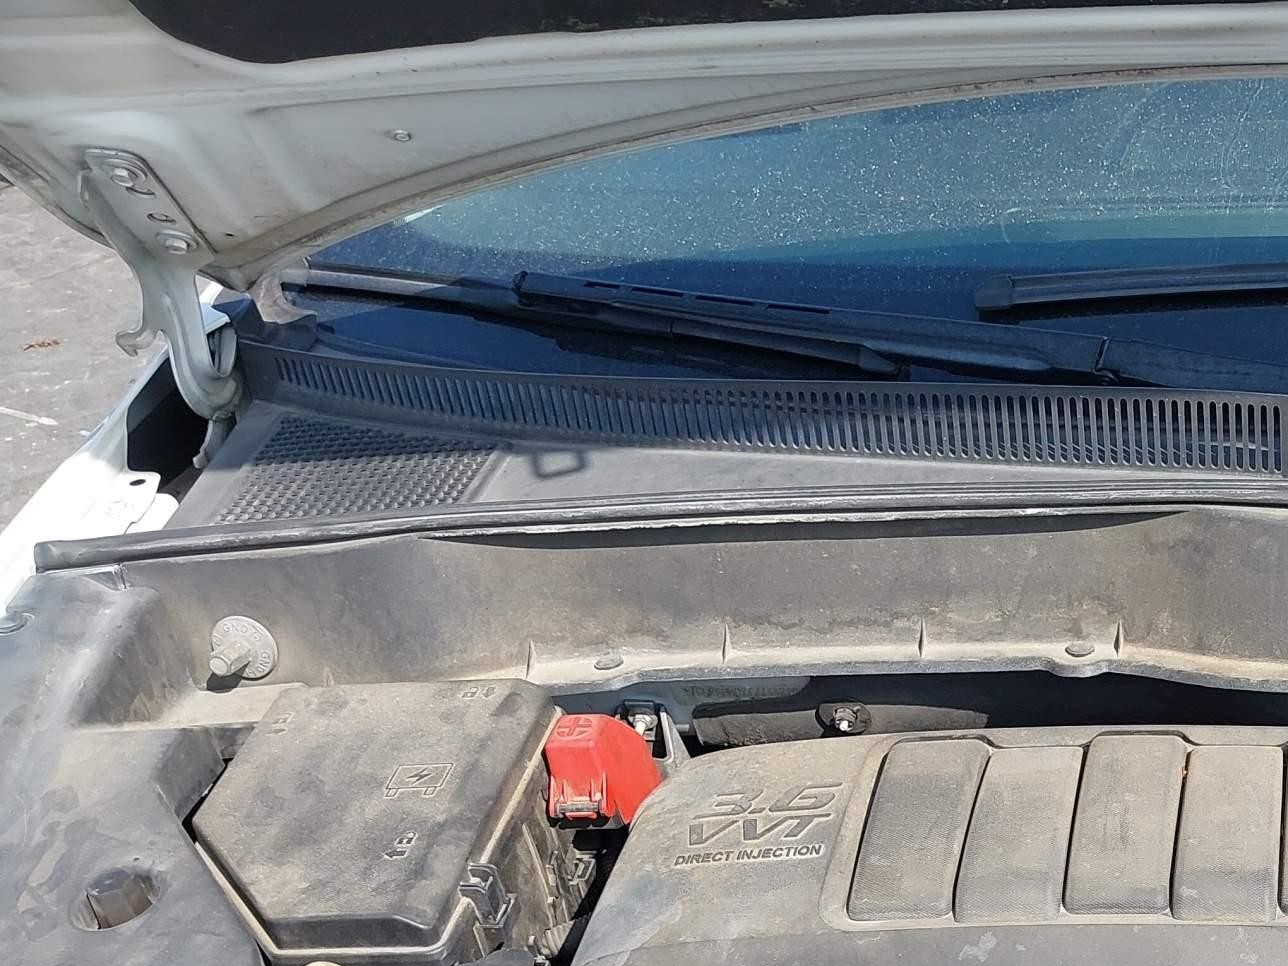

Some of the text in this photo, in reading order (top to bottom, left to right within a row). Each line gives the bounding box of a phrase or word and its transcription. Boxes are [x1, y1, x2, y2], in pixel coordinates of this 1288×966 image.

[714, 781, 844, 817] 3.6
[687, 812, 832, 847] VVT
[673, 844, 824, 867] DIRECT INJECTION
